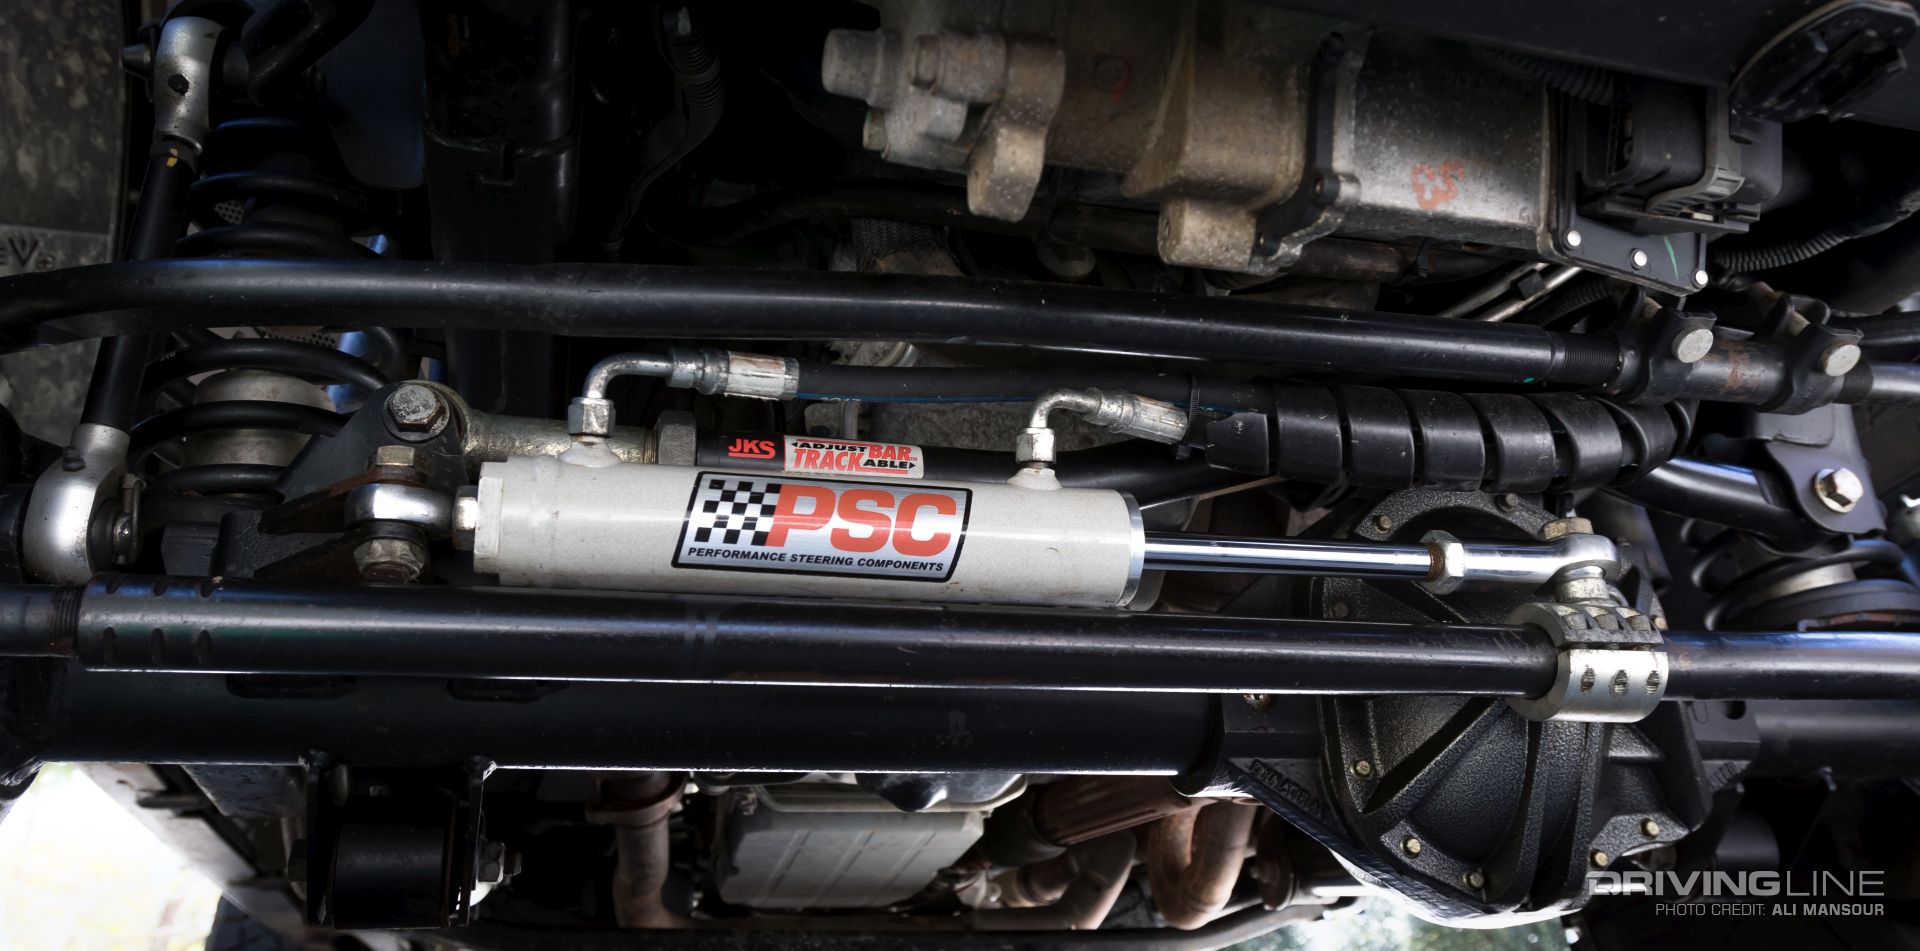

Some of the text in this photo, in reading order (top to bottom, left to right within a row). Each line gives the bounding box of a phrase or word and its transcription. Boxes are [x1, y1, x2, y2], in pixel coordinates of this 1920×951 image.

[728, 438, 776, 460] JKS
[793, 448, 908, 472] TRACK ABLE
[798, 442, 868, 453] ADJUST
[868, 444, 912, 461] BAR
[765, 483, 957, 557] PSC
[687, 547, 945, 573] PERFORMANCE STEERING COMPONENTS
